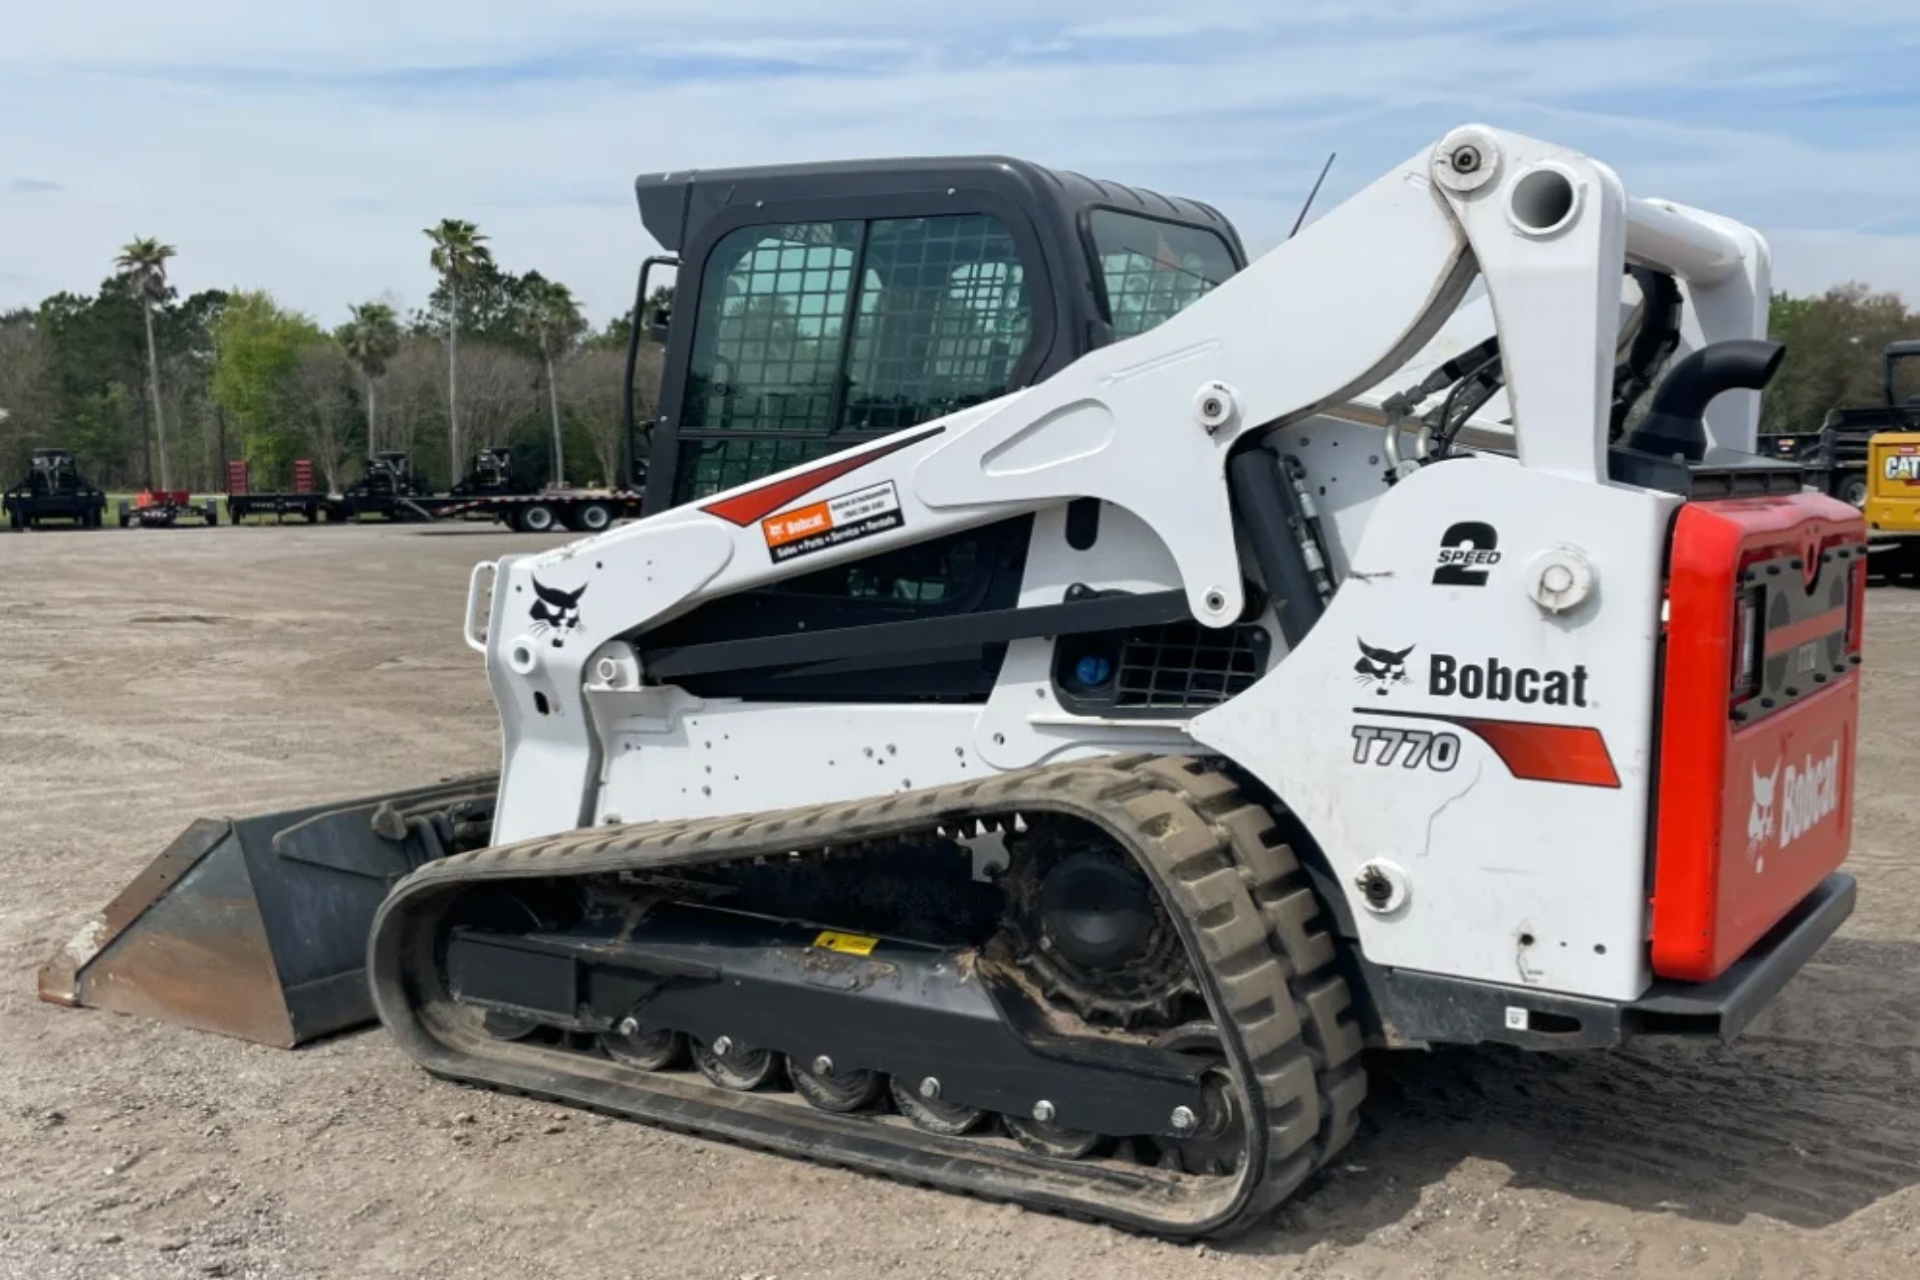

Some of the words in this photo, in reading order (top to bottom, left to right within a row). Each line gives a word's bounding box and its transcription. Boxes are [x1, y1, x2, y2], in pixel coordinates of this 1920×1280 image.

[1885, 456, 1920, 479] CAT
[776, 544, 798, 558] Sales
[804, 535, 825, 550] Parts
[831, 525, 860, 542] Service
[867, 515, 897, 531] Rentals
[786, 513, 825, 535] Bobcat
[1431, 521, 1498, 587] 2
[1437, 550, 1502, 565] SPEED
[1428, 653, 1588, 708] Bobcat
[1351, 725, 1461, 772] T770
[1780, 739, 1839, 849] Bobcat
